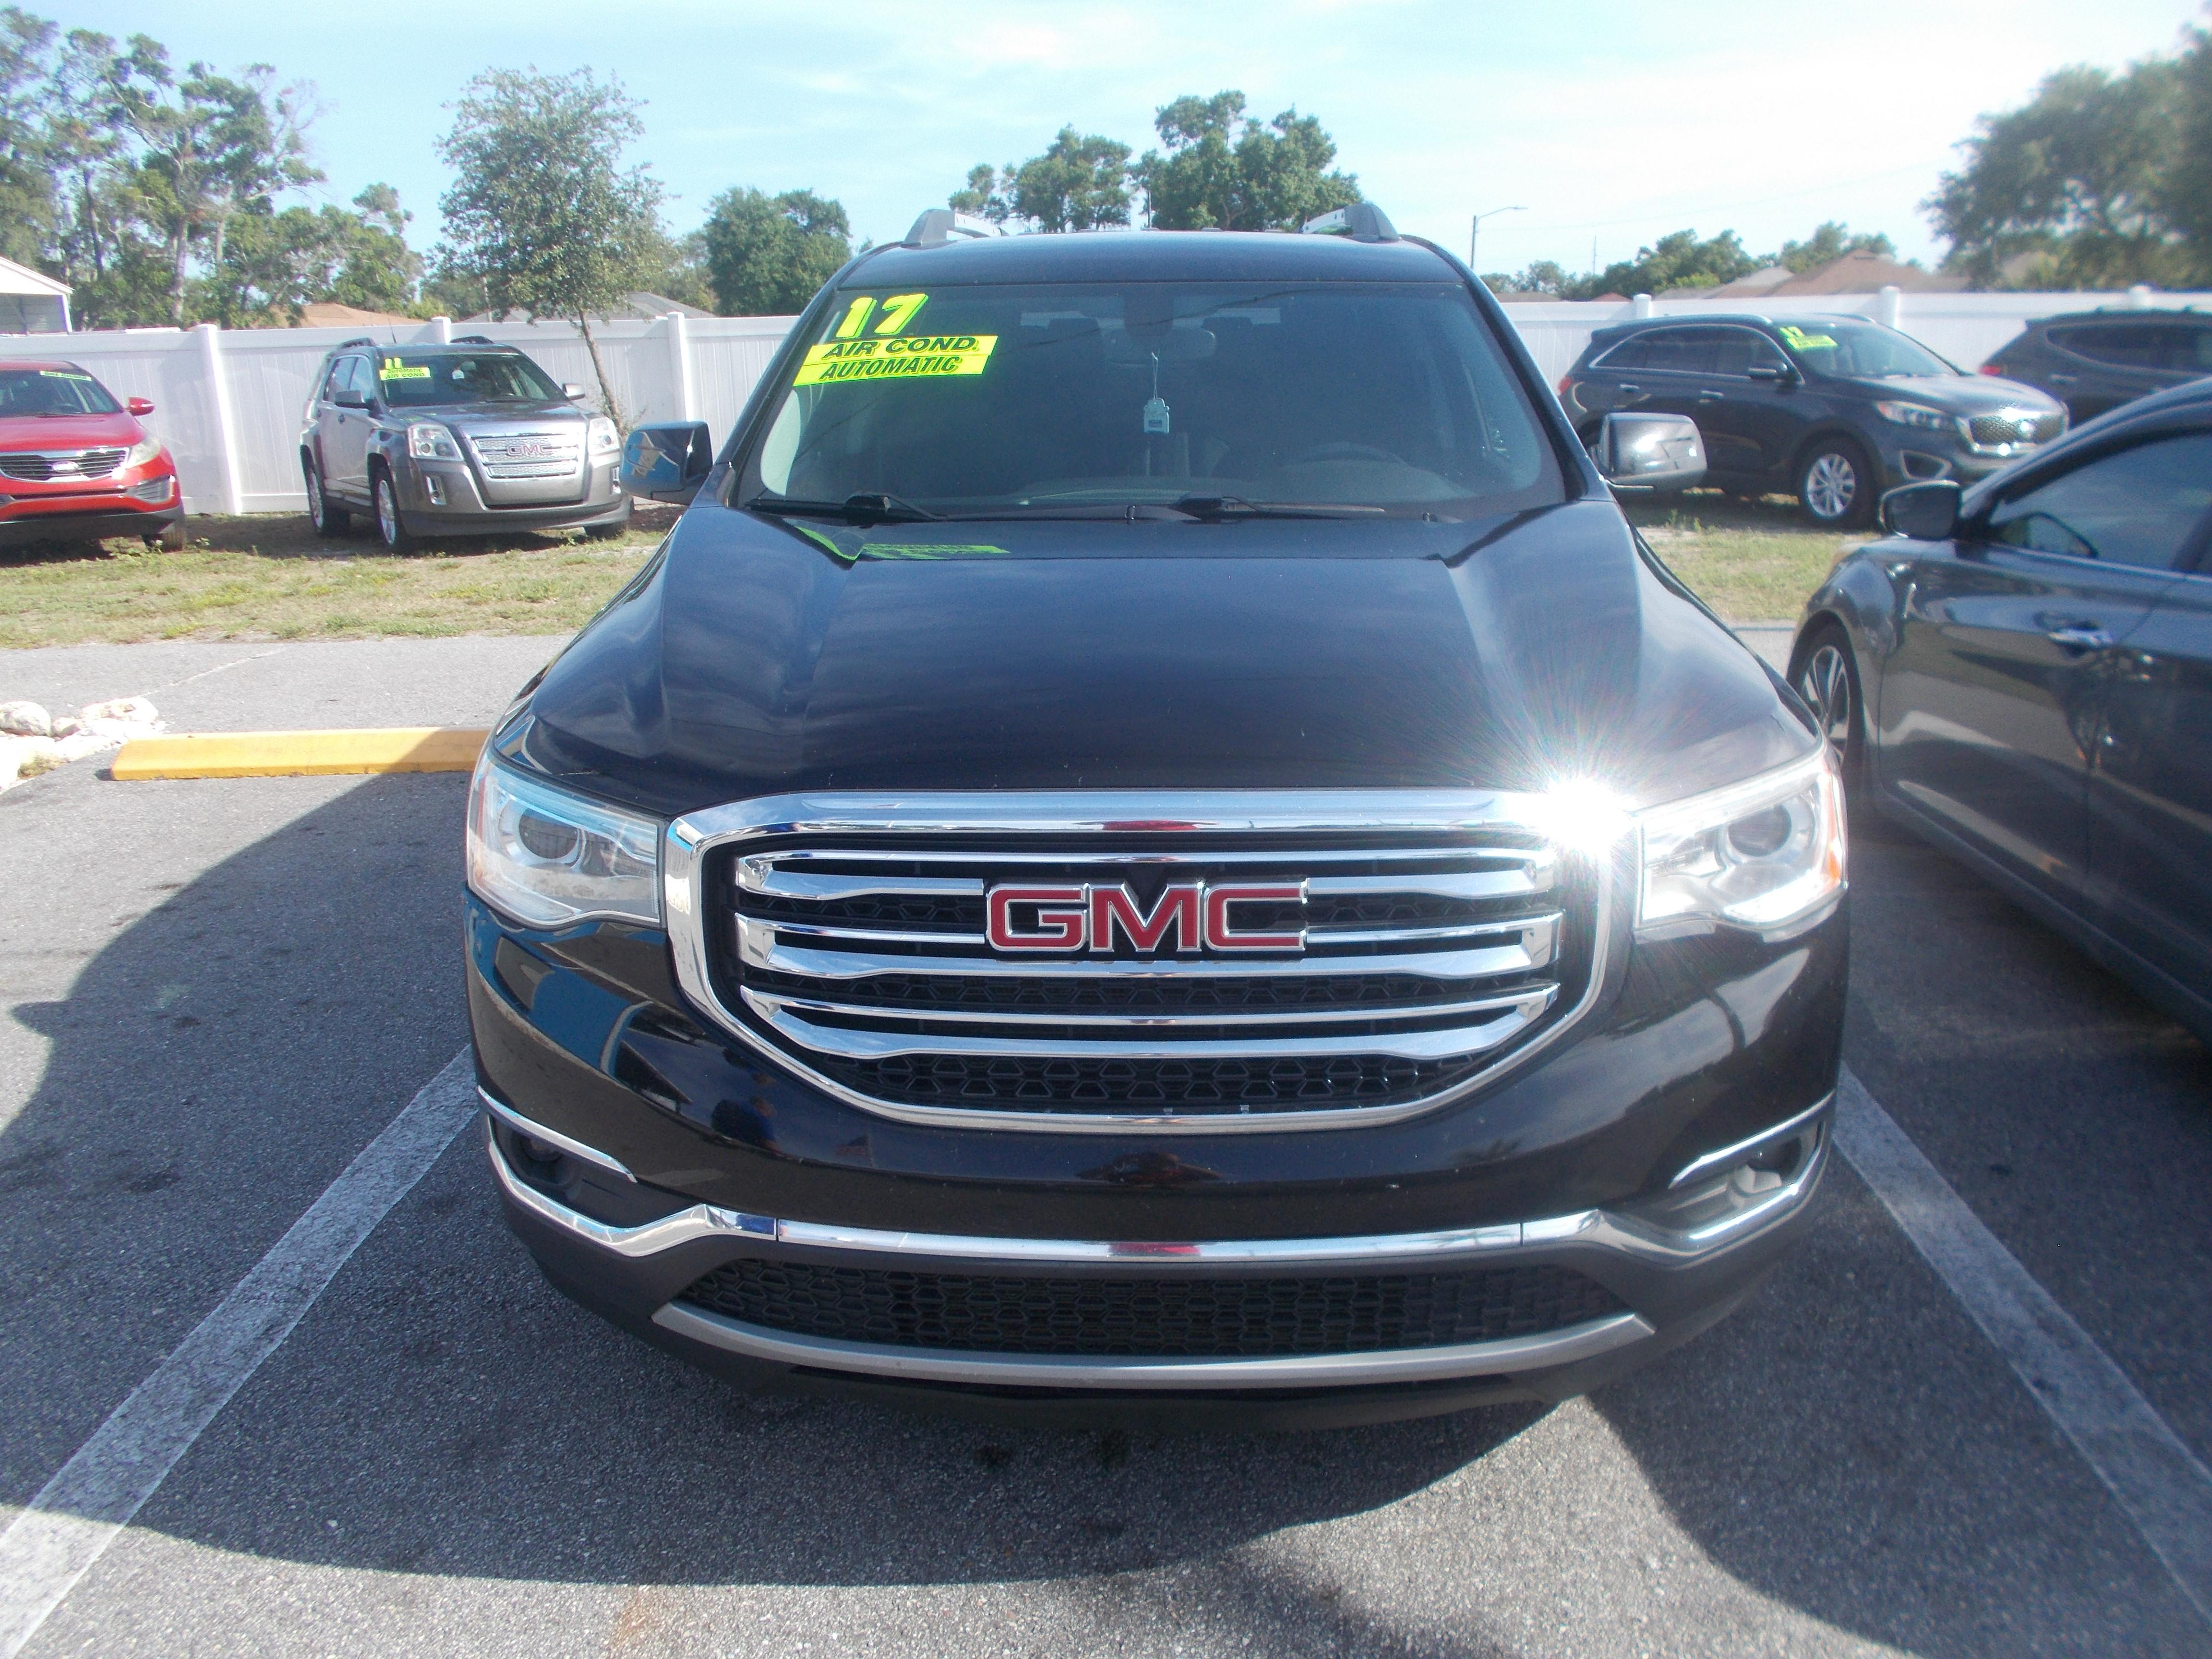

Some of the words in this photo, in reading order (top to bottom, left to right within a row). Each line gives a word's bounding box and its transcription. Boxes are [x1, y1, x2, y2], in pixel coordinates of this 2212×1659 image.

[836, 293, 928, 339] 17
[821, 341, 880, 360] AIR
[385, 358, 402, 369] 11
[819, 356, 962, 380] AUTOMATIC
[506, 444, 554, 456] GMC
[986, 883, 1308, 951] GMC
